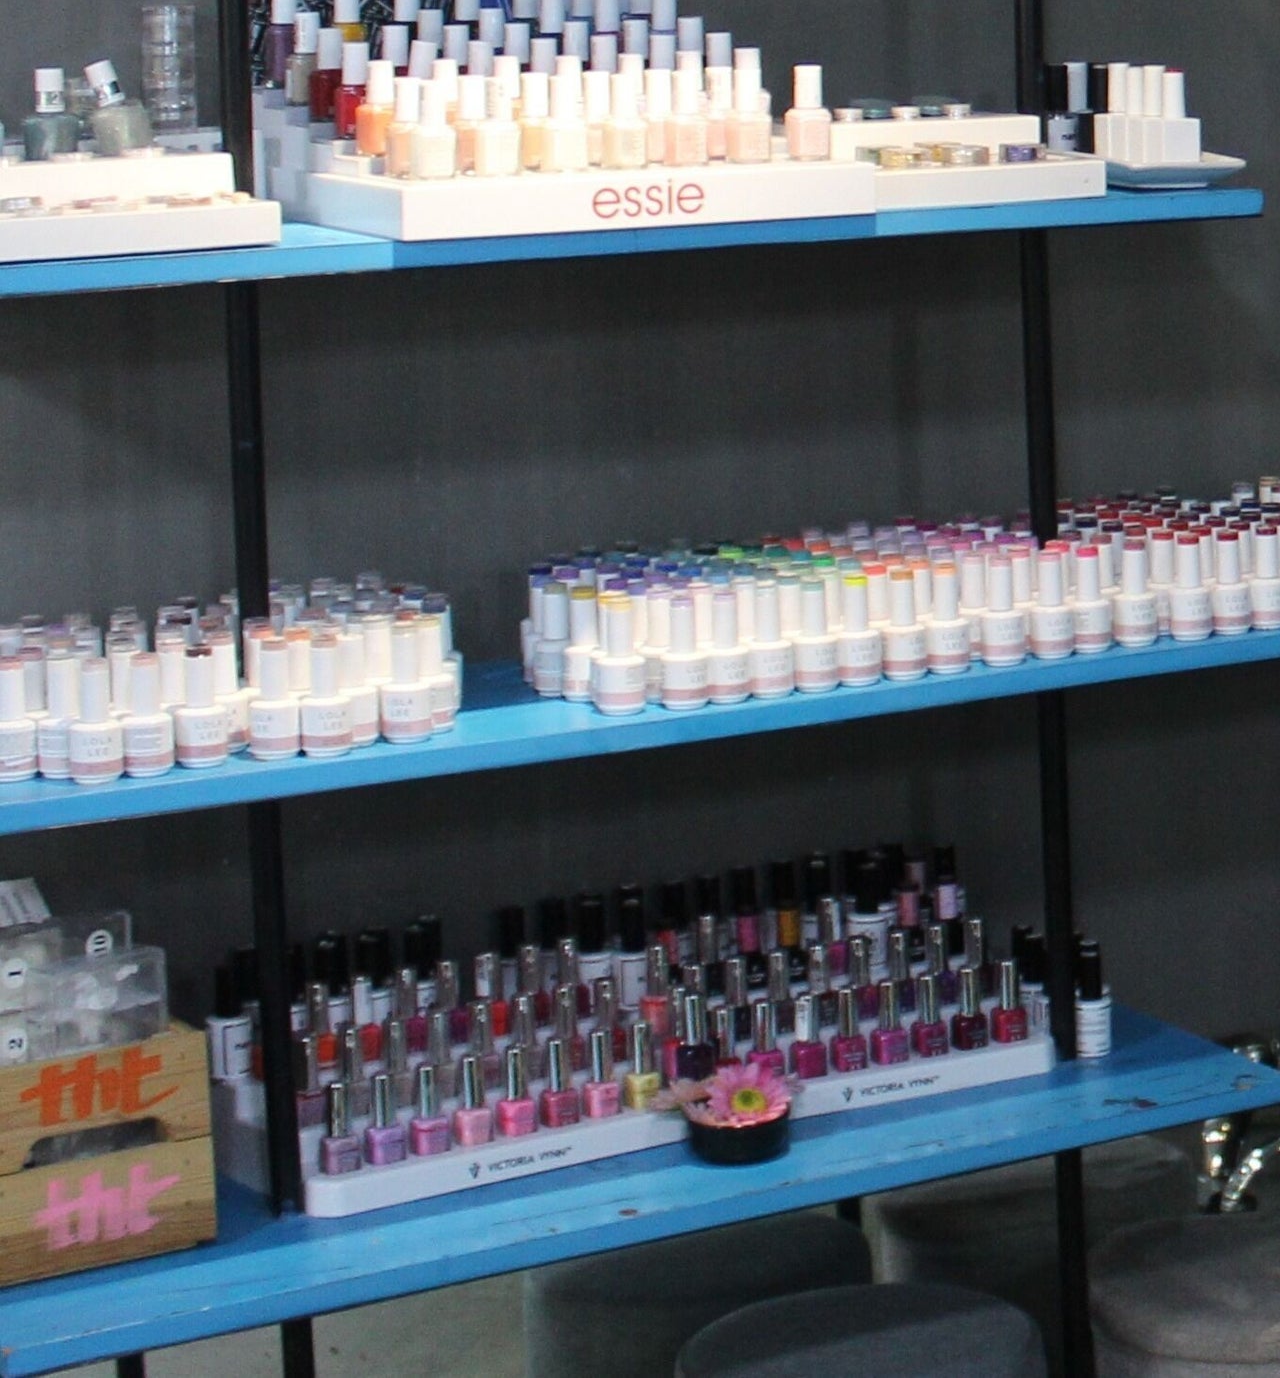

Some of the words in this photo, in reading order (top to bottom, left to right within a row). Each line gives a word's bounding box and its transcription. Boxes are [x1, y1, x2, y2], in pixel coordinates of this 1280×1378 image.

[592, 178, 705, 219] essie
[93, 934, 107, 952] 10
[8, 1037, 24, 1050] 2
[487, 1155, 535, 1171] VICTORIA
